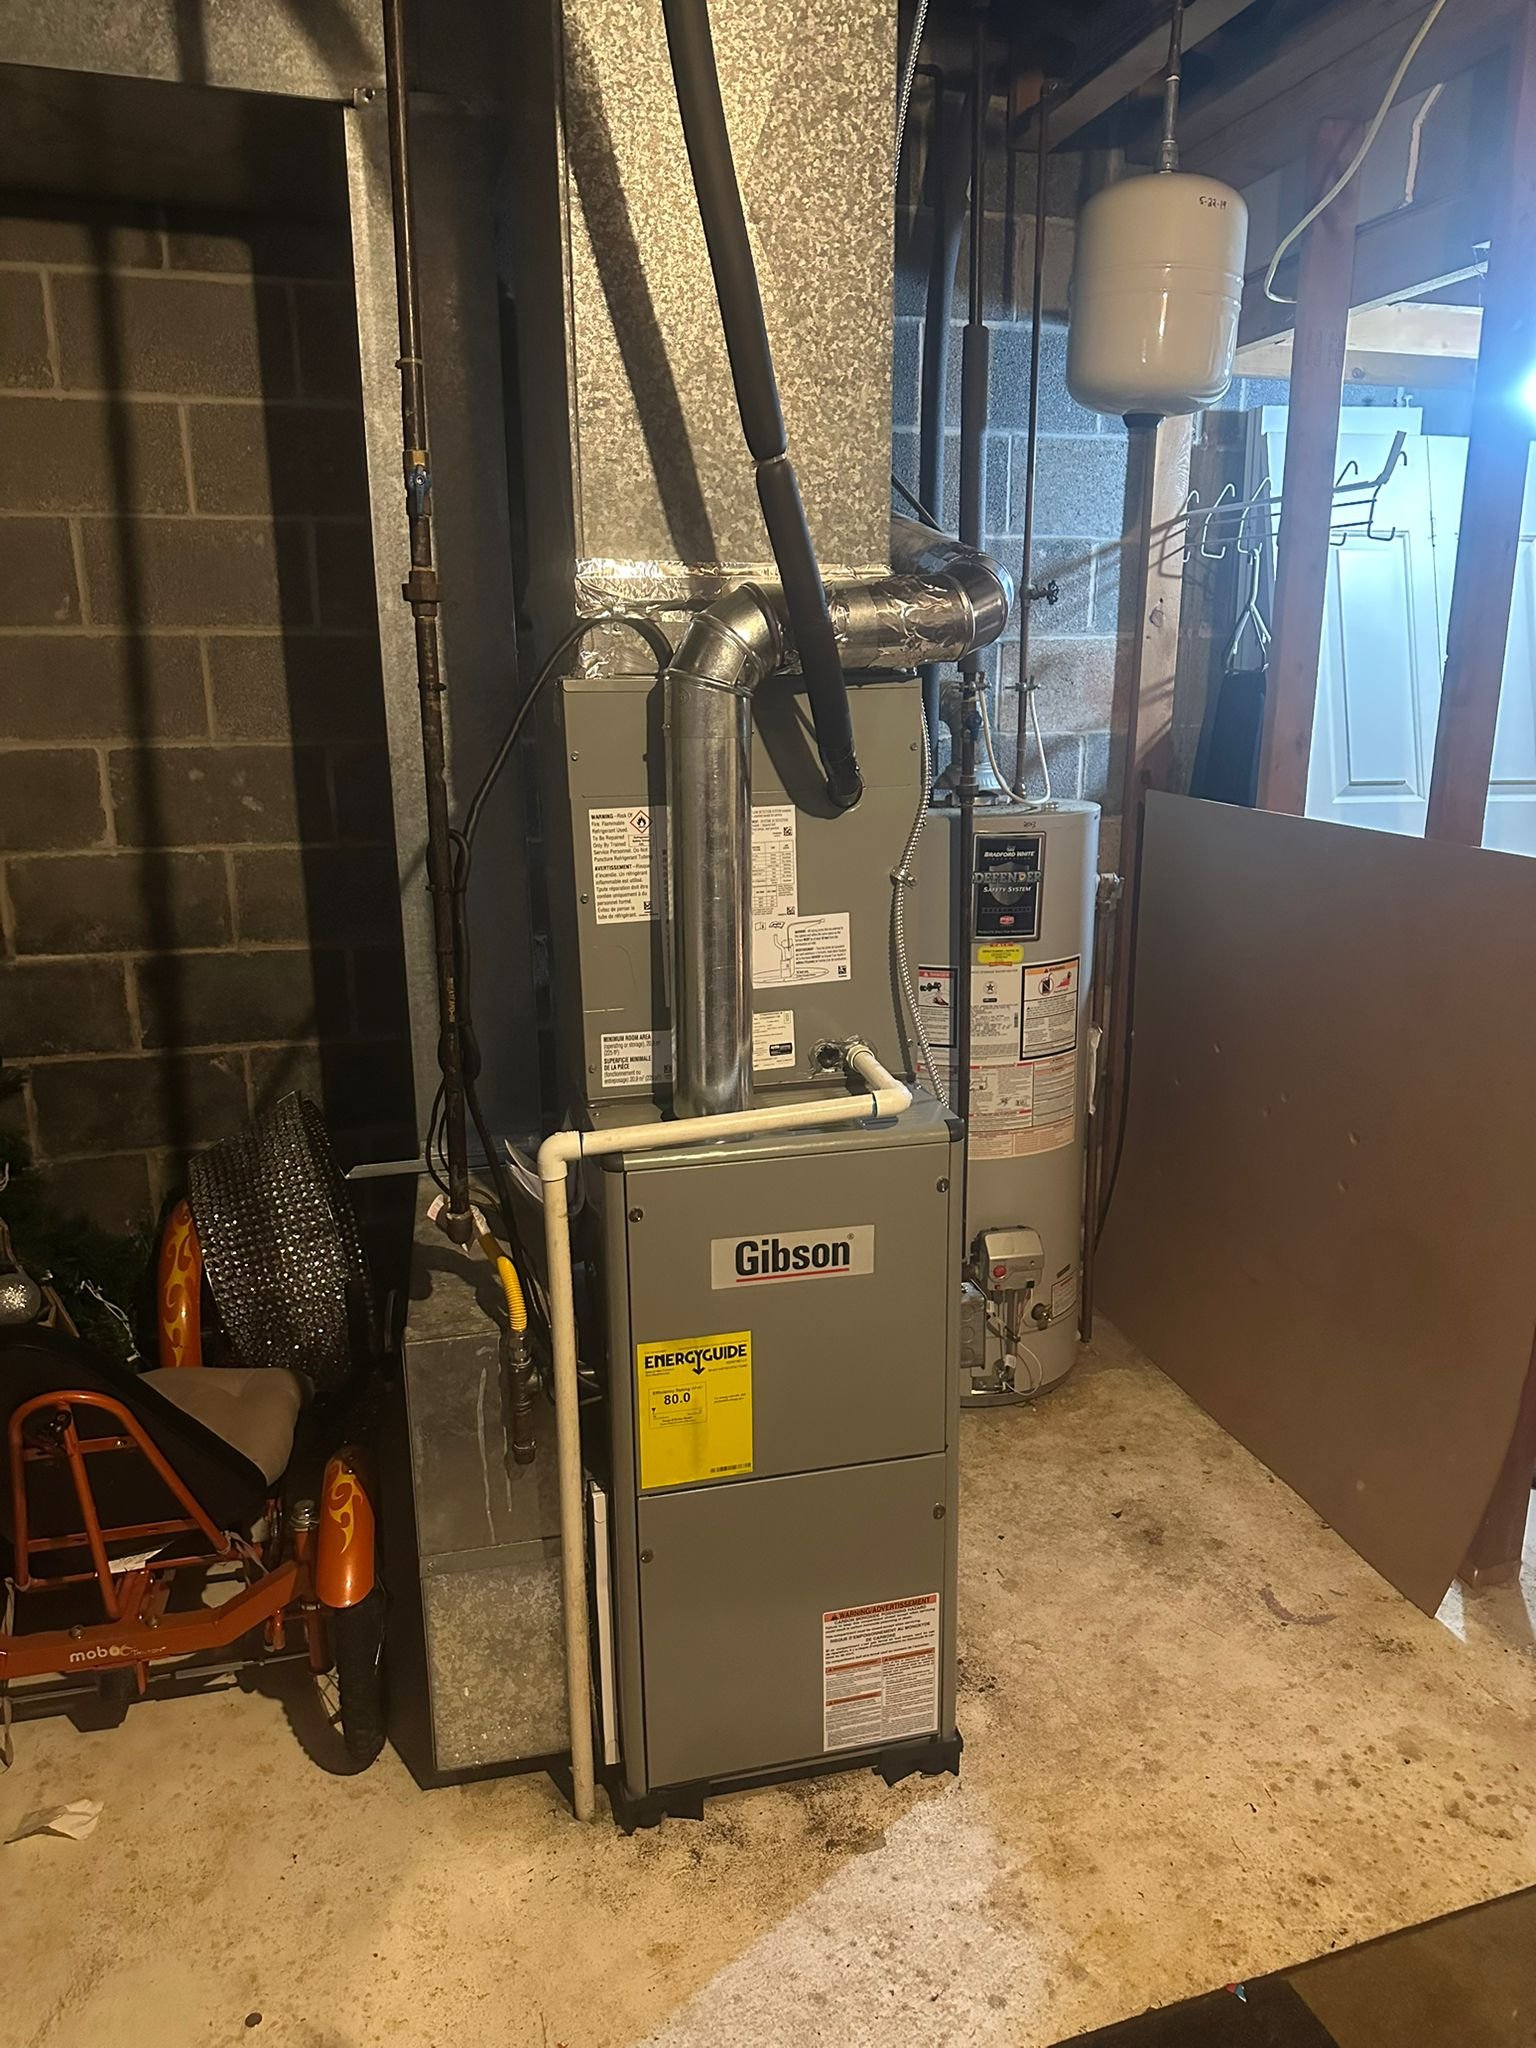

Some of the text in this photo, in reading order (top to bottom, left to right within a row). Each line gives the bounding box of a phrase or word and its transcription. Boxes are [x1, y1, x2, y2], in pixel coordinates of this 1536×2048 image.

[973, 871, 1041, 884] DEFENDER
[735, 1238, 850, 1276] Gibson
[644, 1344, 747, 1374] ENERGYGUIDE
[664, 1392, 691, 1405] 80.0
